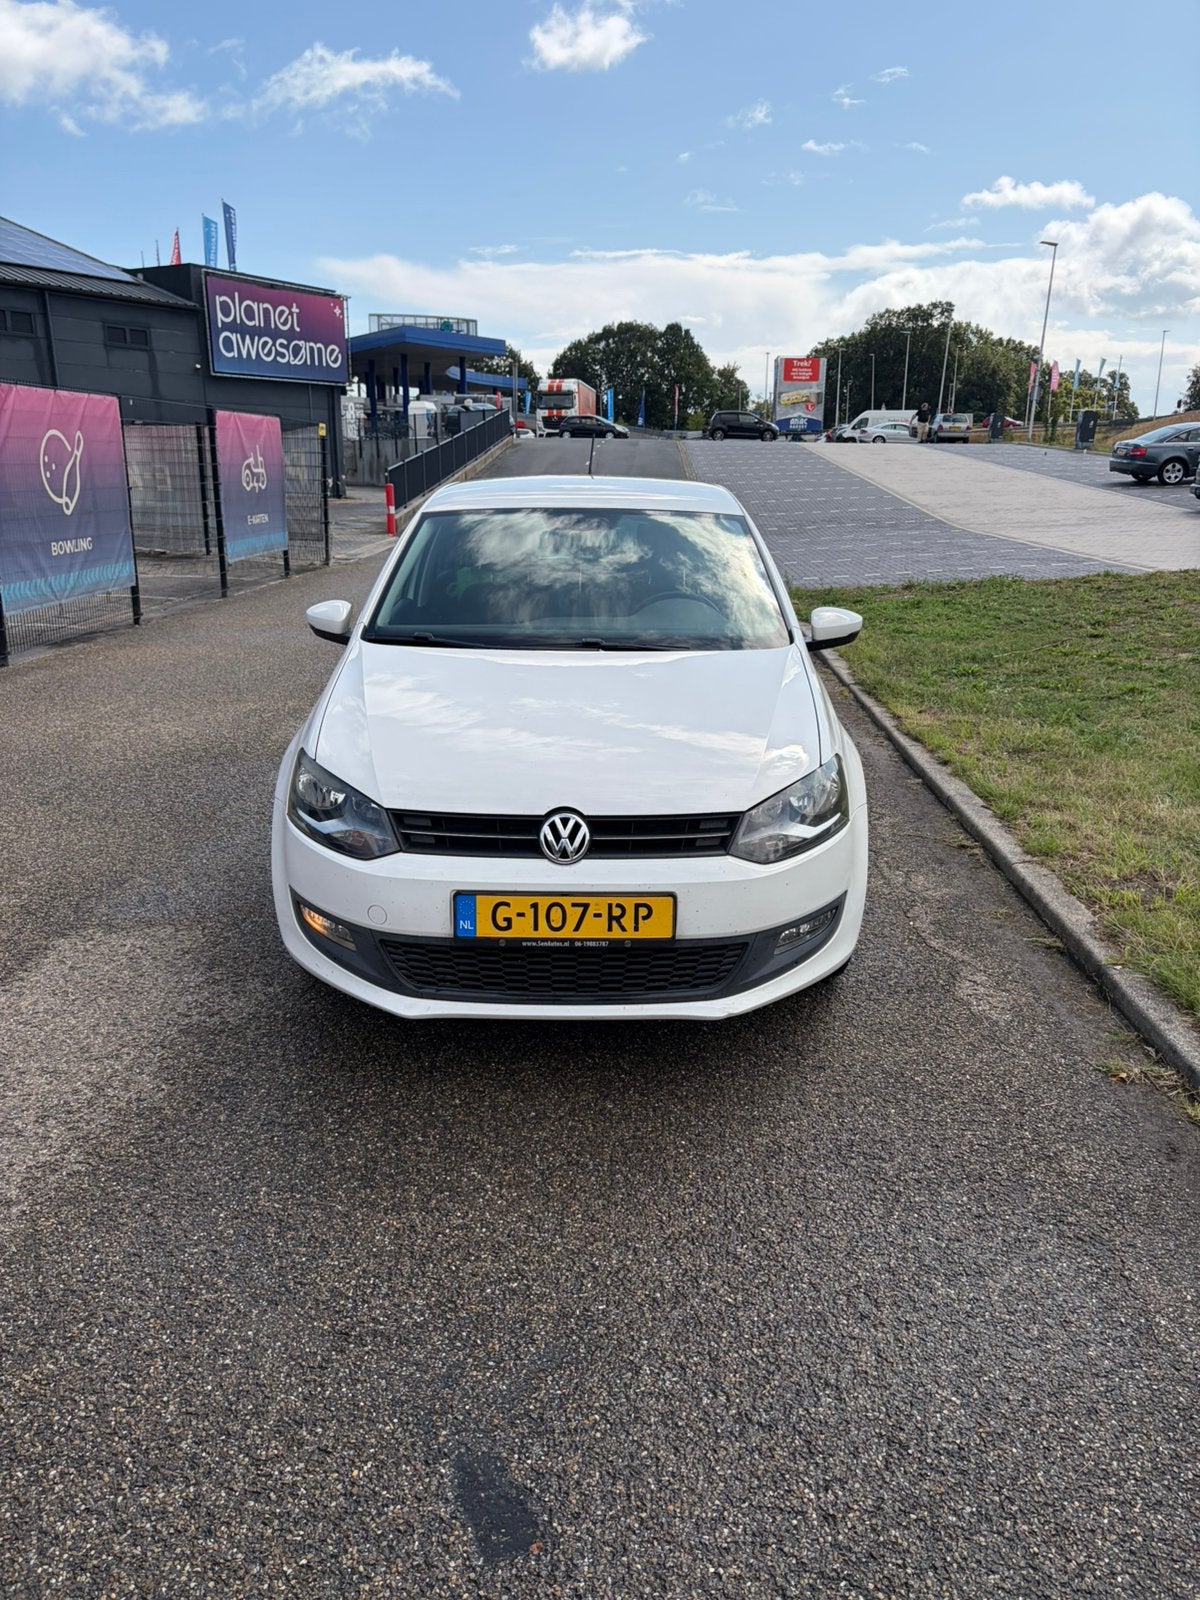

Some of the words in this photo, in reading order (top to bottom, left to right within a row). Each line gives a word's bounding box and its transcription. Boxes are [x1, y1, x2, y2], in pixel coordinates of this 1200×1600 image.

[215, 291, 301, 332] planet
[218, 331, 342, 368] awesome
[51, 536, 93, 556] BOWLING
[460, 919, 474, 930] NL
[491, 901, 653, 932] G-107-RP
